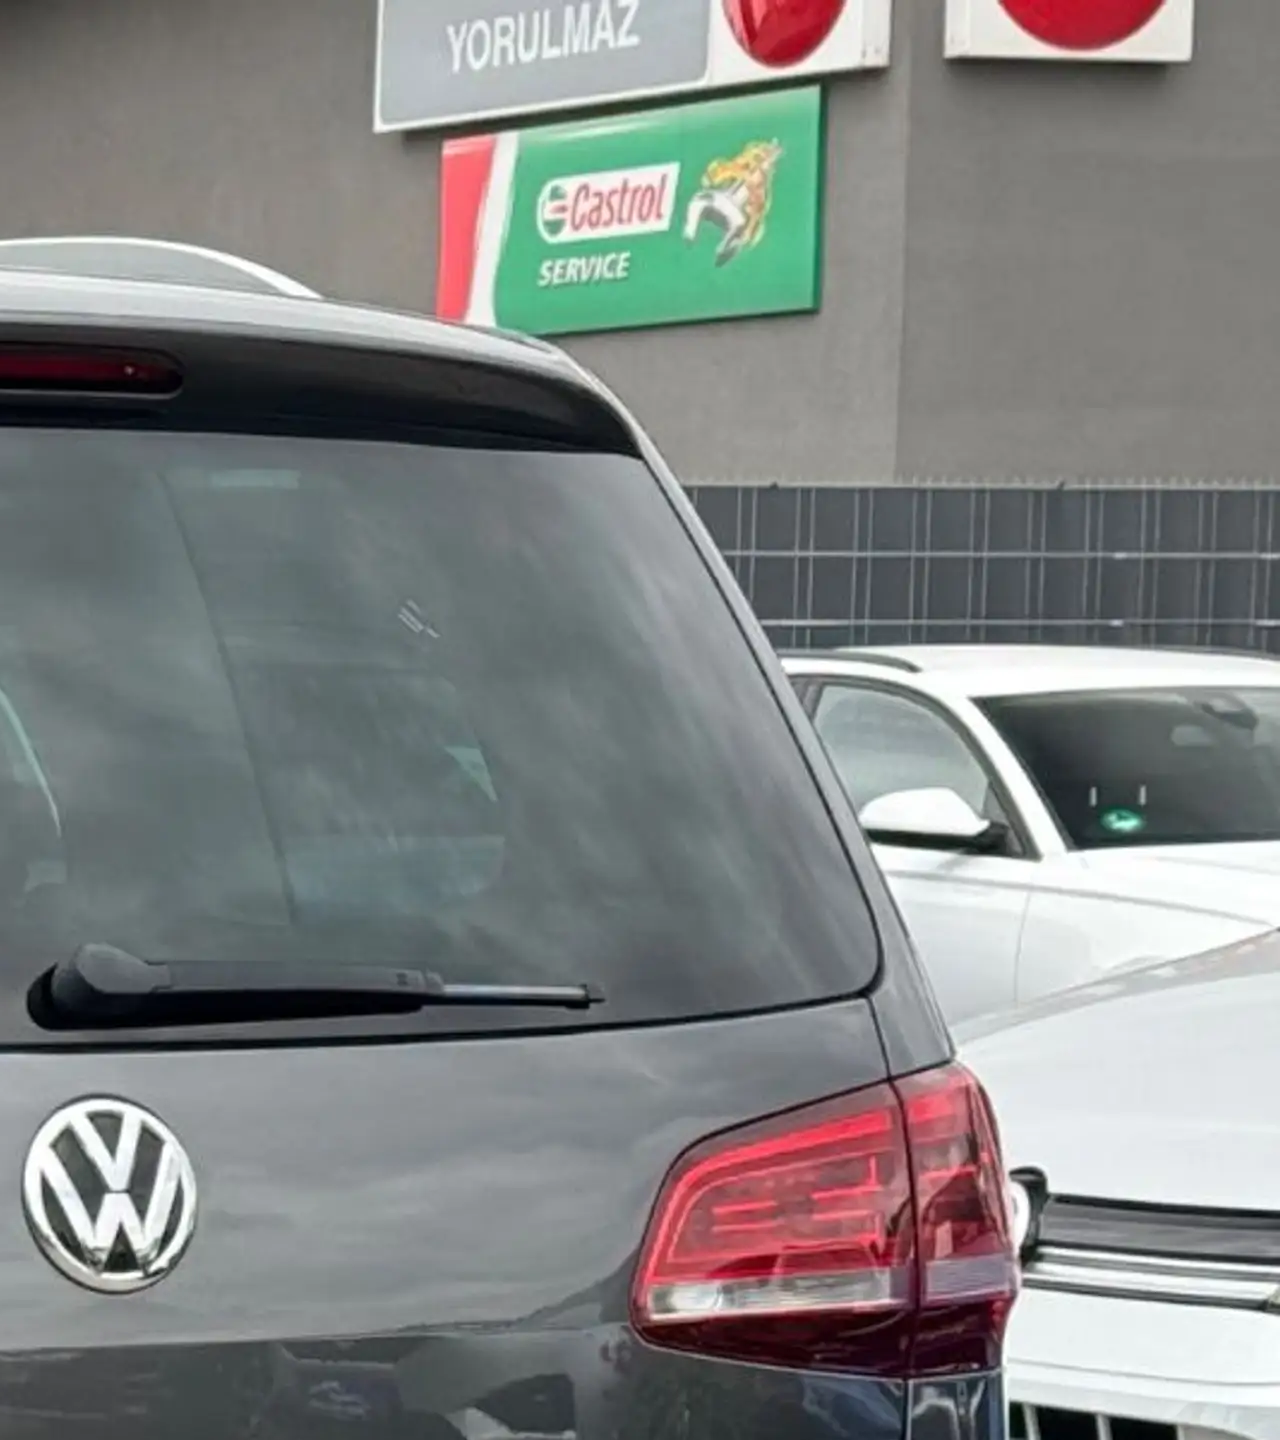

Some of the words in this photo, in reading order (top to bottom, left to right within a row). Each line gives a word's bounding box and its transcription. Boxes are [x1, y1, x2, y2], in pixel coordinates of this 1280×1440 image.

[446, 0, 640, 74] YORULMAZ
[571, 173, 668, 232] Castrol
[537, 251, 631, 287] SERVICE
